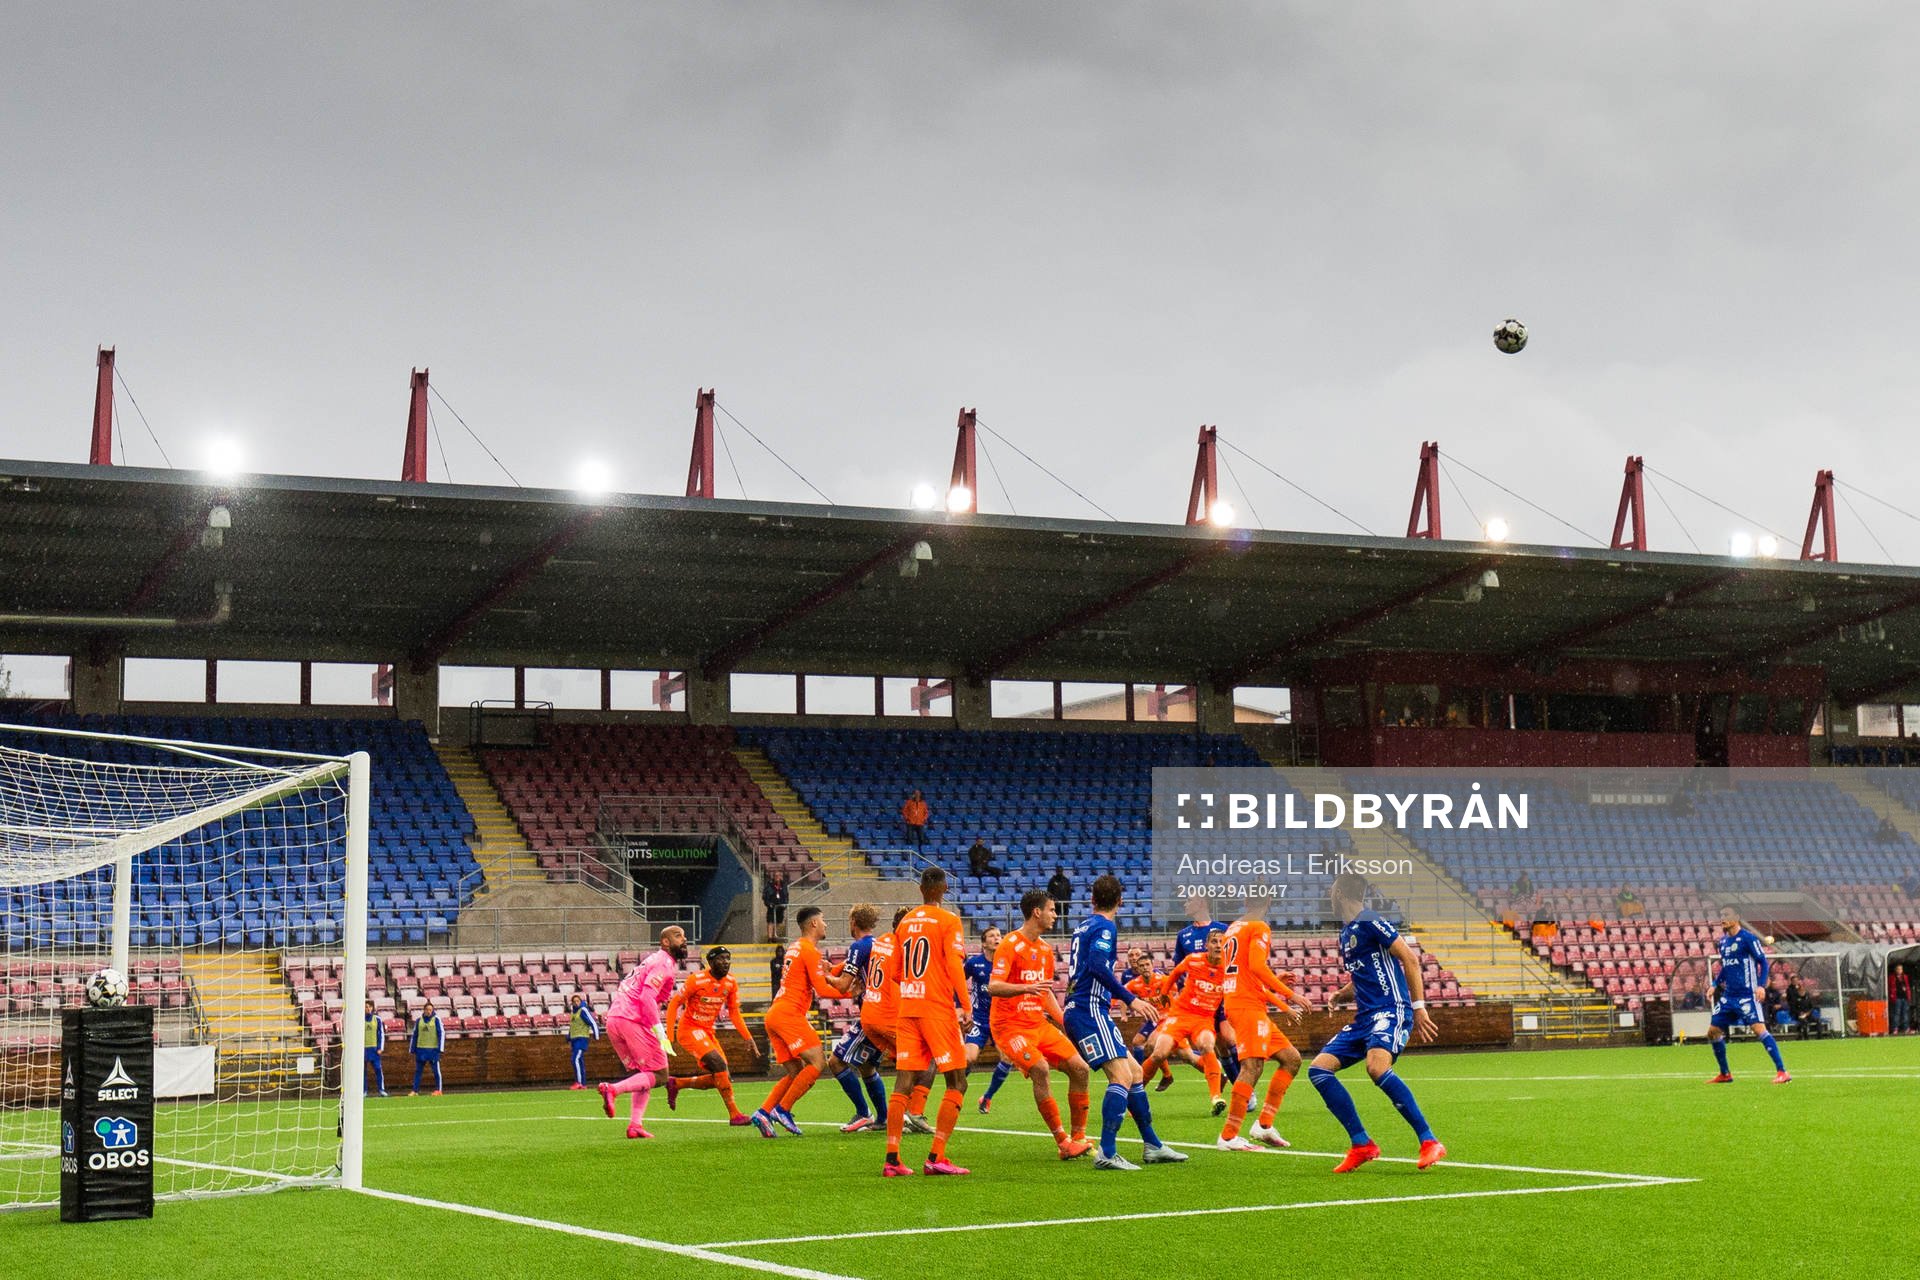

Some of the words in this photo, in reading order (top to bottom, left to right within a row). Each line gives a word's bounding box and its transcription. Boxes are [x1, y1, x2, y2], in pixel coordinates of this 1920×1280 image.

[867, 955, 885, 989] 16
[903, 936, 931, 980] 10
[98, 1087, 139, 1101] SELECT
[88, 1149, 150, 1171] OBOS
